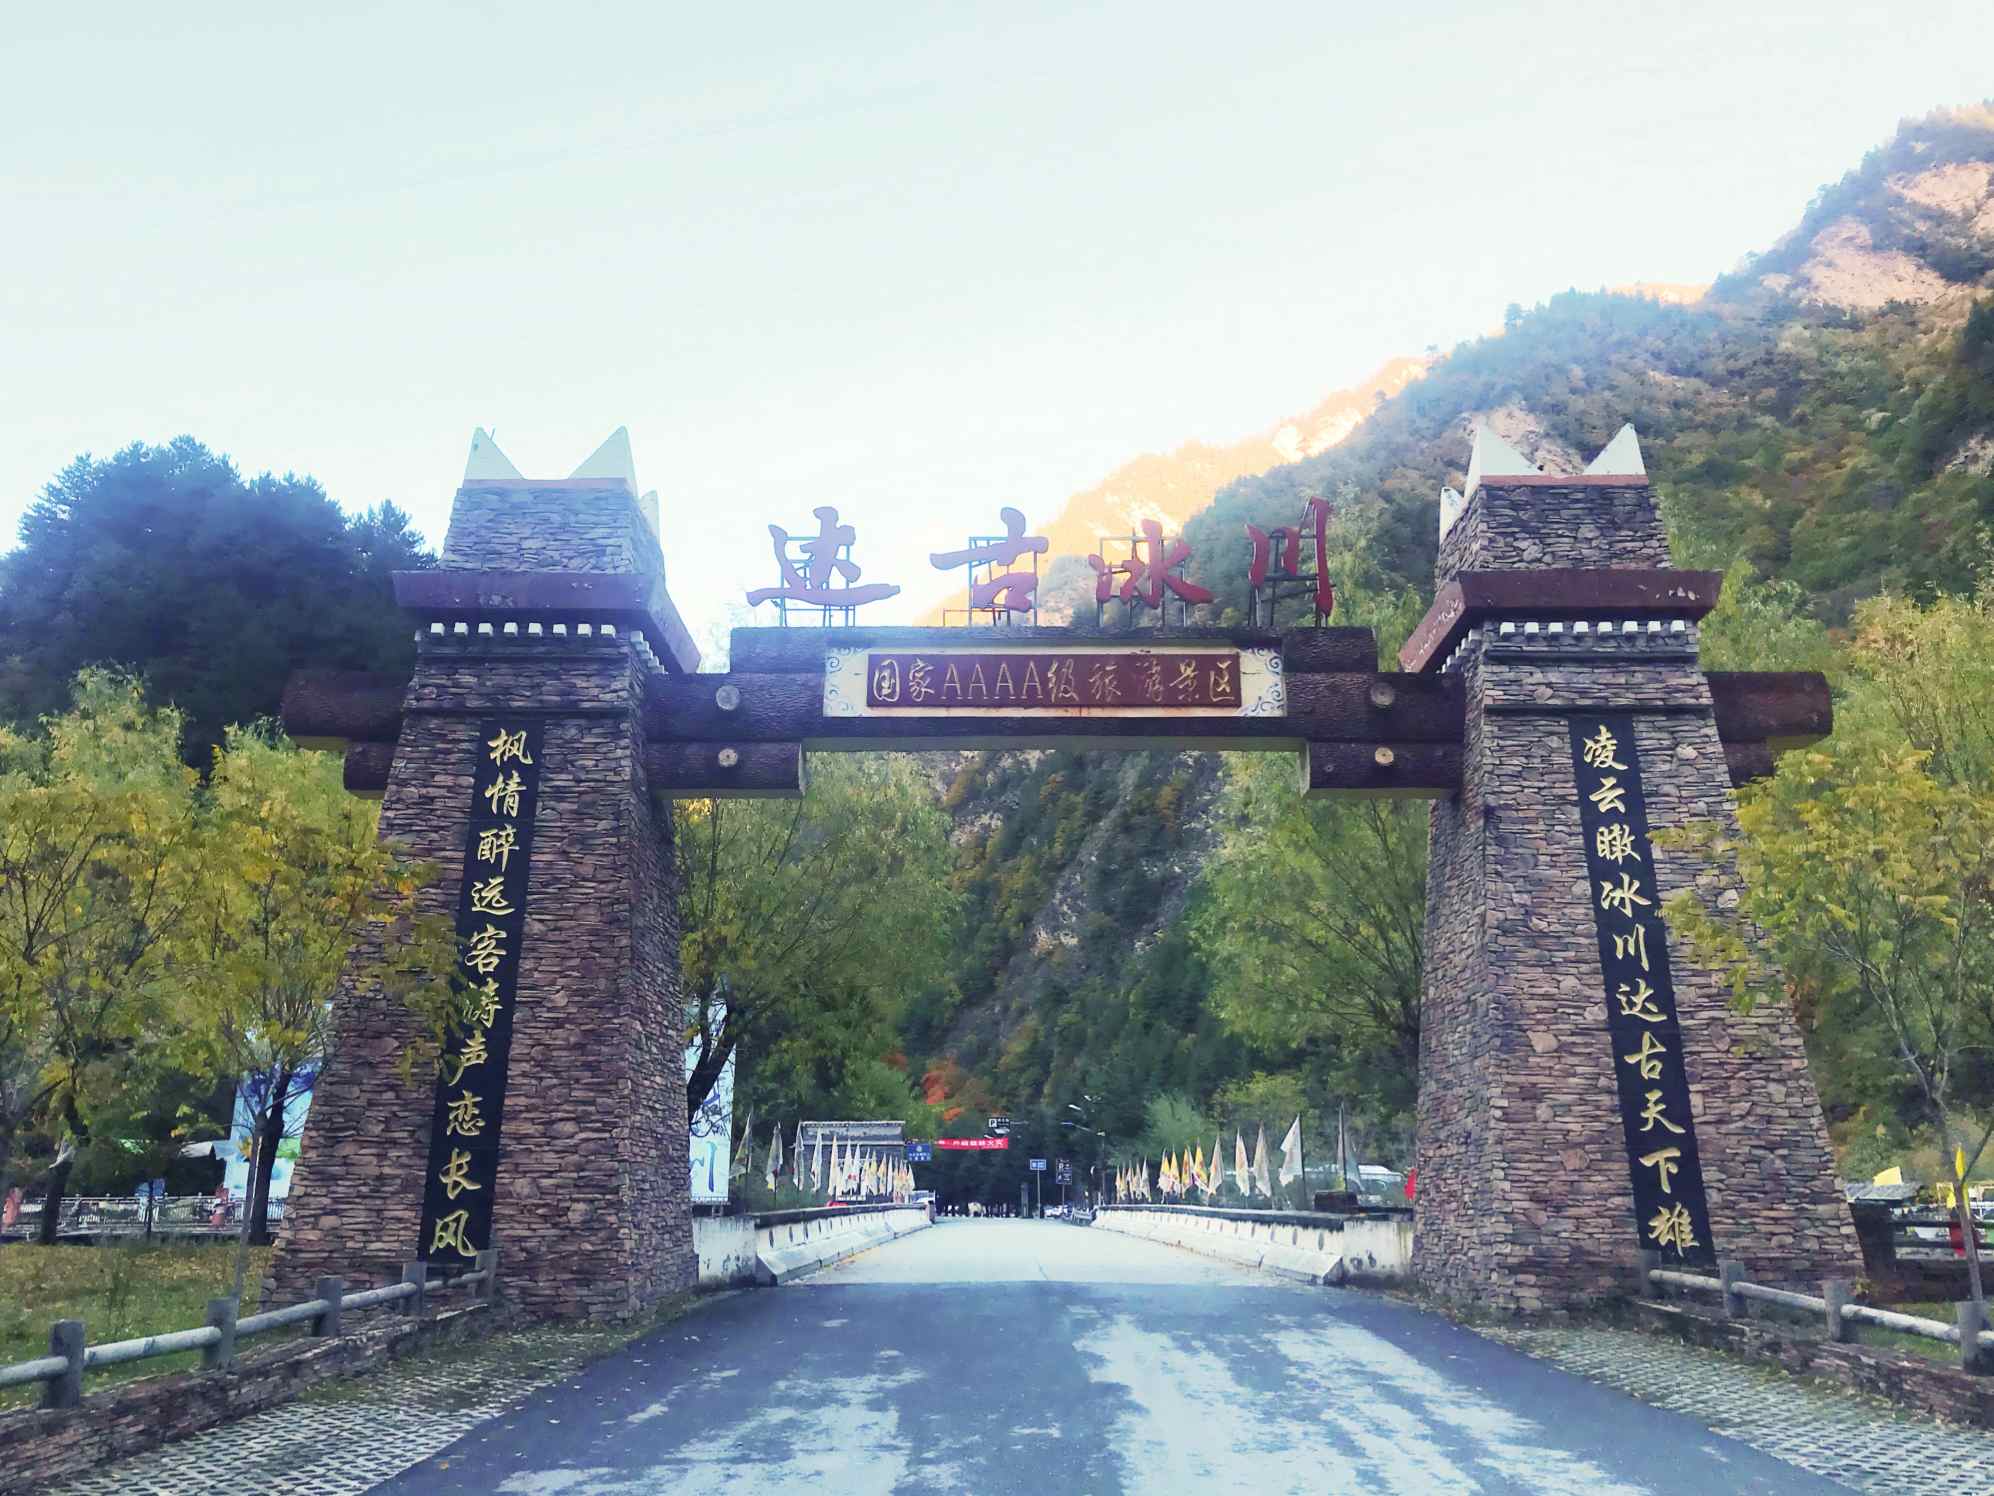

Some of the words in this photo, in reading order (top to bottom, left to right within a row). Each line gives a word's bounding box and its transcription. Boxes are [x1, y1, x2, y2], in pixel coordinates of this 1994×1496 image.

[746, 497, 1335, 616] 达古冰川
[1583, 724, 1701, 1258] 凌云瞰冰川达古天下雄
